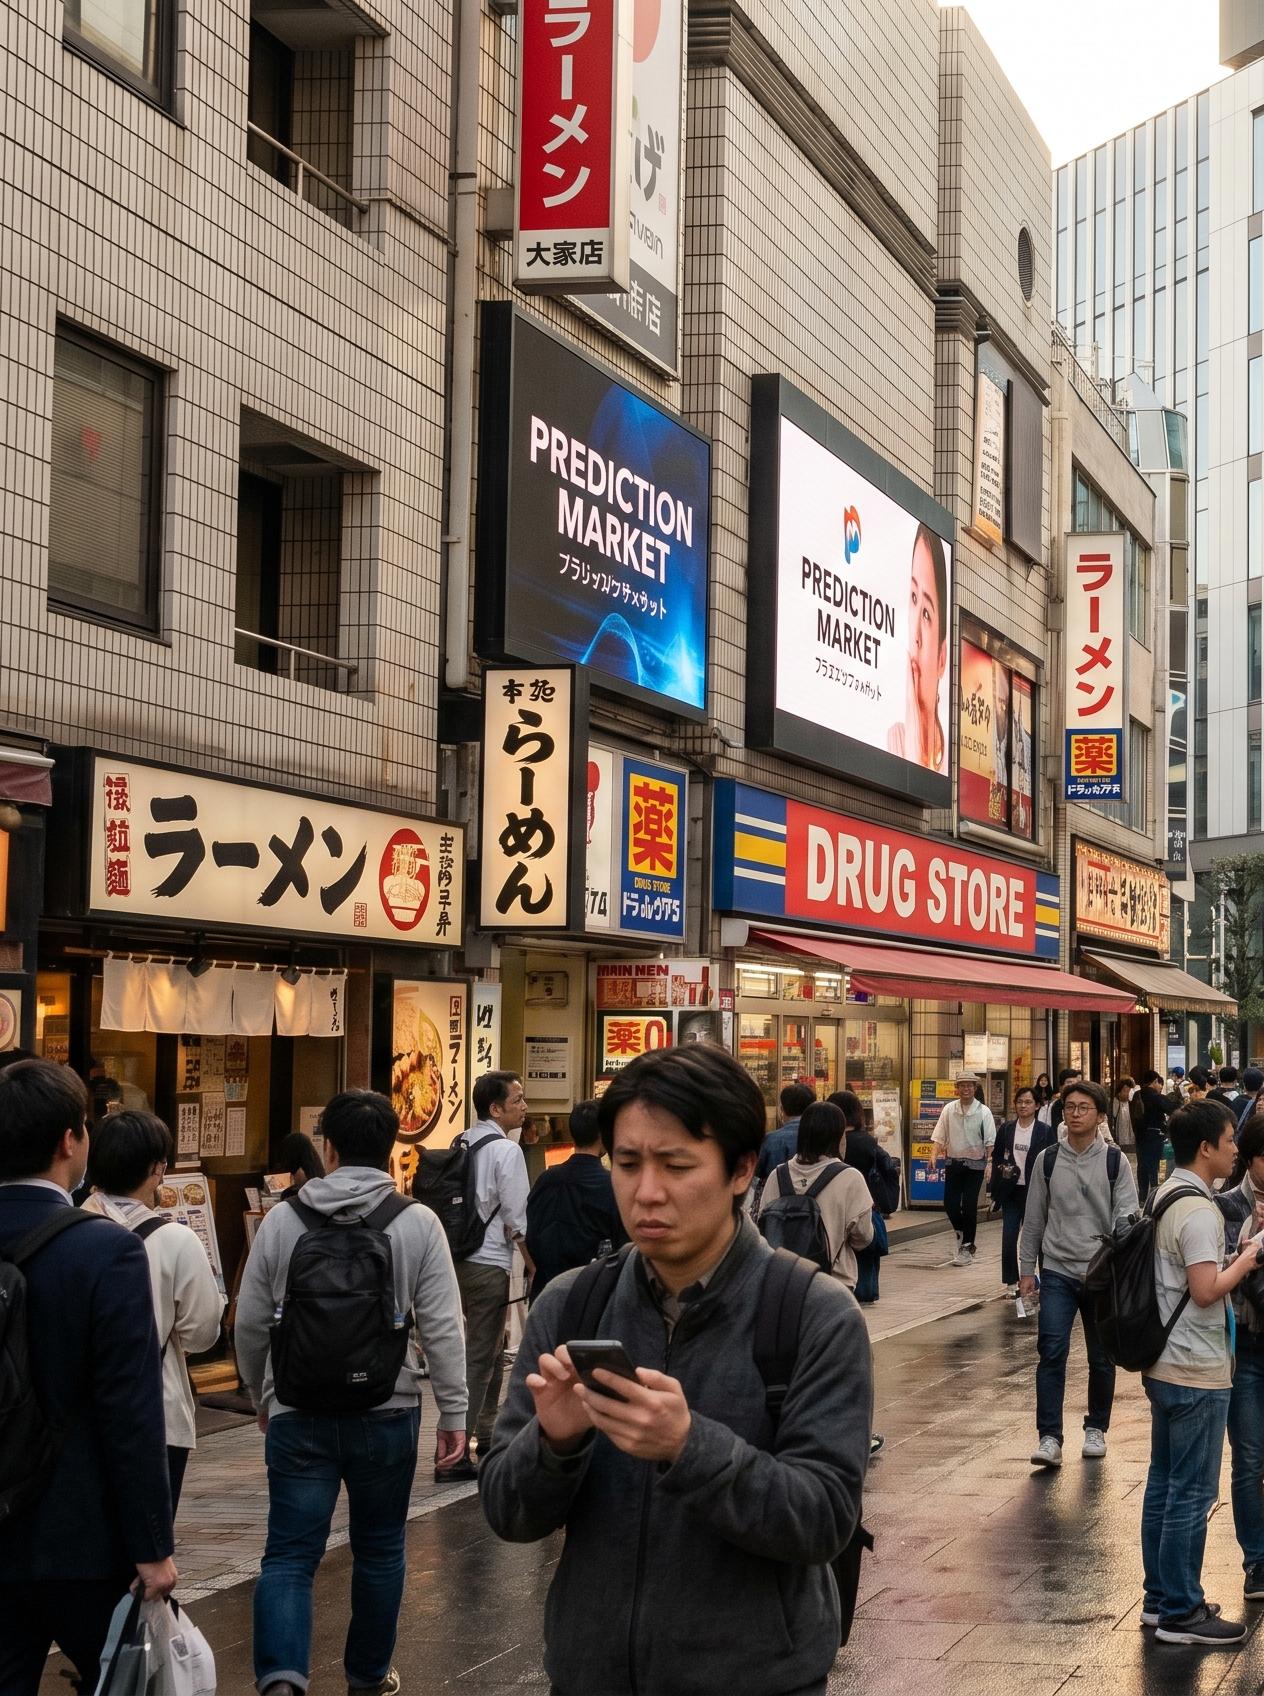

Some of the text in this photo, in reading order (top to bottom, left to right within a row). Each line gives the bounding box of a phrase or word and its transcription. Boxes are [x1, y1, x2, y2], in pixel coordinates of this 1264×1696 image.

[542, 0, 591, 208] ラーメン
[526, 239, 604, 267] 大家店
[530, 415, 693, 547] PREDICTION
[558, 487, 671, 584] MARKET
[802, 555, 895, 638] PREDICTION
[817, 608, 881, 669] MARKET
[1075, 553, 1115, 717] ラーメン
[1074, 736, 1114, 775] 薬
[144, 795, 367, 915] ラーメン
[495, 709, 555, 915] らーめん
[633, 782, 674, 872] 薬
[807, 824, 916, 918] DRUG
[927, 858, 1024, 938] STORE
[635, 965, 669, 977] MEN
[607, 1021, 642, 1054] 薬
